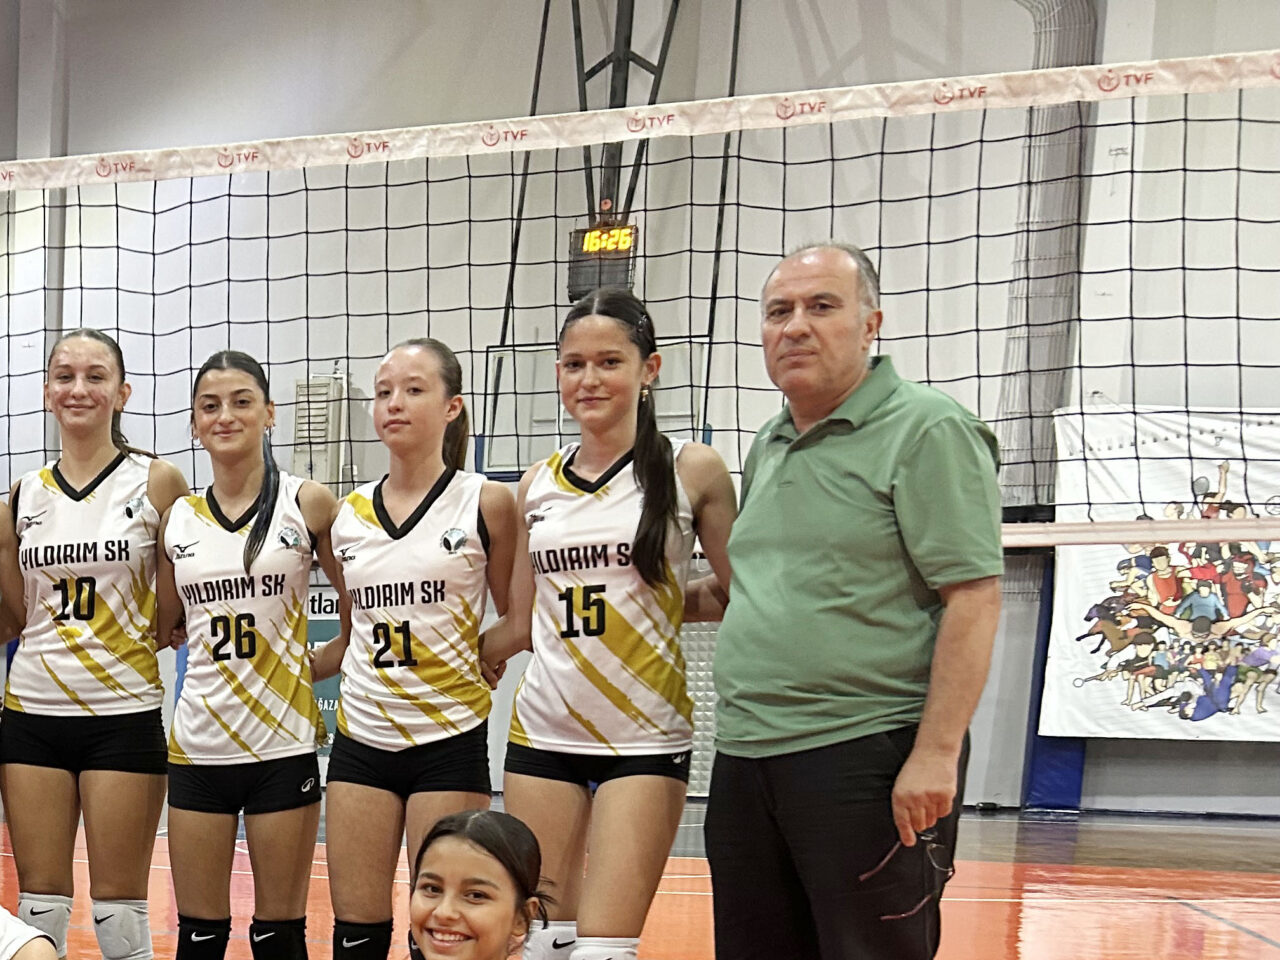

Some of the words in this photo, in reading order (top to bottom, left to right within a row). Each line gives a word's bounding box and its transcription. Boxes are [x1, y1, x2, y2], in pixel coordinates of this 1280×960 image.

[1122, 73, 1154, 86] TVF
[958, 86, 987, 99] TVF
[799, 102, 827, 114] TVF
[649, 114, 675, 127] TVF
[366, 141, 389, 152] TVF
[504, 130, 527, 141] TVF
[113, 162, 135, 173] TVF
[237, 152, 259, 163] TVF
[583, 228, 632, 252] 16:26
[21, 541, 97, 571] YILDIRIM
[104, 540, 130, 562] SK
[616, 542, 631, 567] S
[52, 576, 96, 621] 10
[181, 575, 256, 606] YILDIRIM
[261, 574, 286, 597] SK
[420, 579, 446, 604] SK
[558, 584, 607, 639] 15
[210, 612, 256, 662] 26
[373, 620, 418, 669] 21
